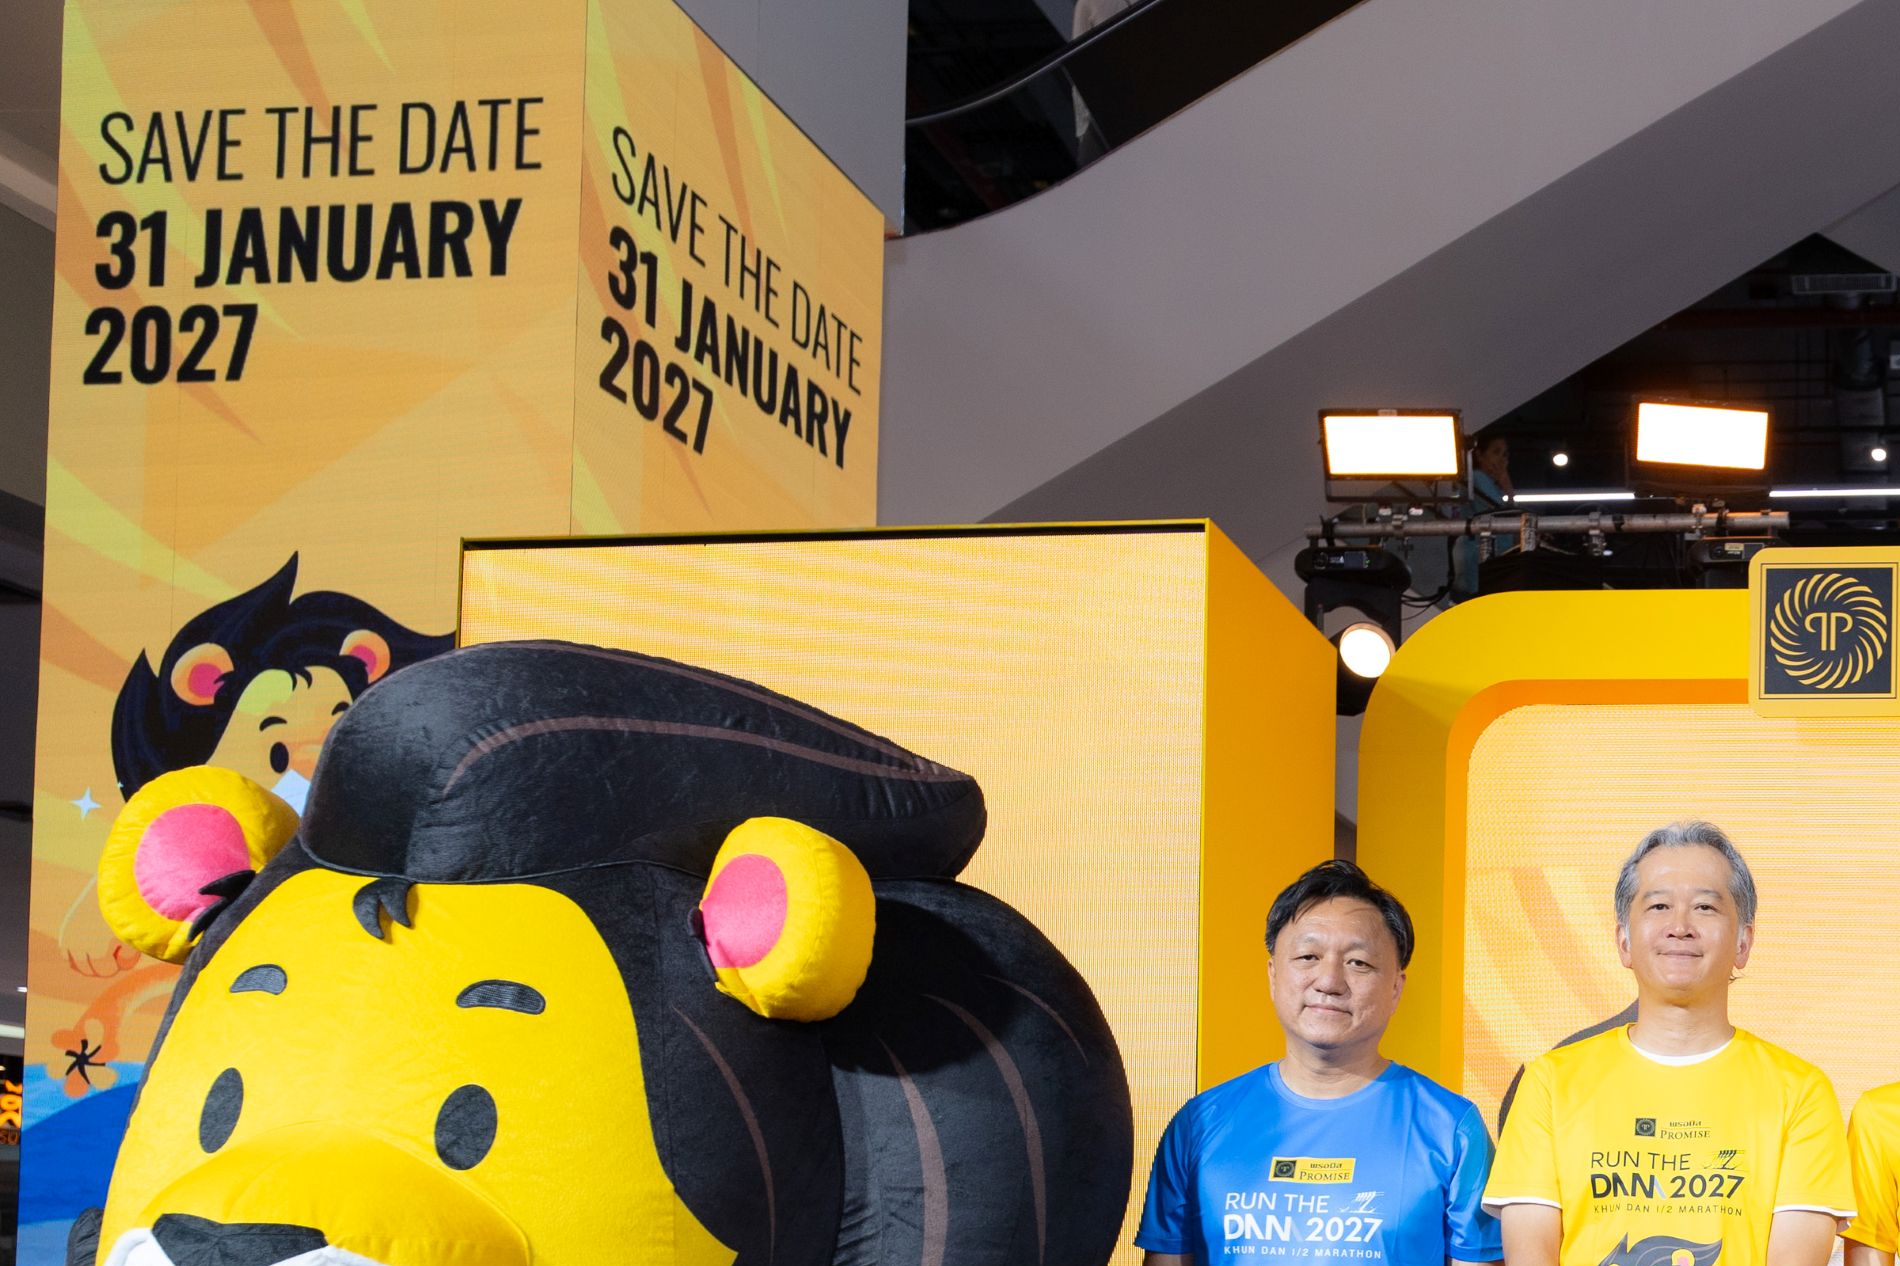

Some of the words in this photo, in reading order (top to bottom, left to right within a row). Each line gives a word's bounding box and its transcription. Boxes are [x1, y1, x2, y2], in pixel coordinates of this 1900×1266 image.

[98, 109, 246, 186] SAVE
[265, 104, 376, 180] THE
[399, 97, 545, 175] DATE
[94, 210, 167, 291] 31
[194, 198, 523, 289] JANUARY
[610, 125, 707, 269] SAVE
[718, 215, 781, 330] THE
[791, 280, 863, 397] DATE
[83, 303, 259, 386] 2027
[606, 226, 659, 330] 31
[674, 278, 852, 470] JANUARY
[599, 326, 714, 457] 2027
[1591, 1151, 1640, 1169] RUN
[1647, 1152, 1692, 1171] THE
[1669, 1173, 1745, 1199] 2027
[1225, 1192, 1277, 1211] RUN
[1284, 1193, 1331, 1214] THE
[1304, 1216, 1383, 1243] 2027
[1593, 1203, 1621, 1214] KHUN
[1626, 1203, 1650, 1213] DAN
[1656, 1205, 1673, 1214] 1/2
[1678, 1204, 1742, 1217] MARATHON
[1224, 1246, 1256, 1255] KHUN
[1261, 1246, 1286, 1256] DAN
[1292, 1246, 1309, 1257] 1/2
[1314, 1249, 1382, 1259] MARATHON
